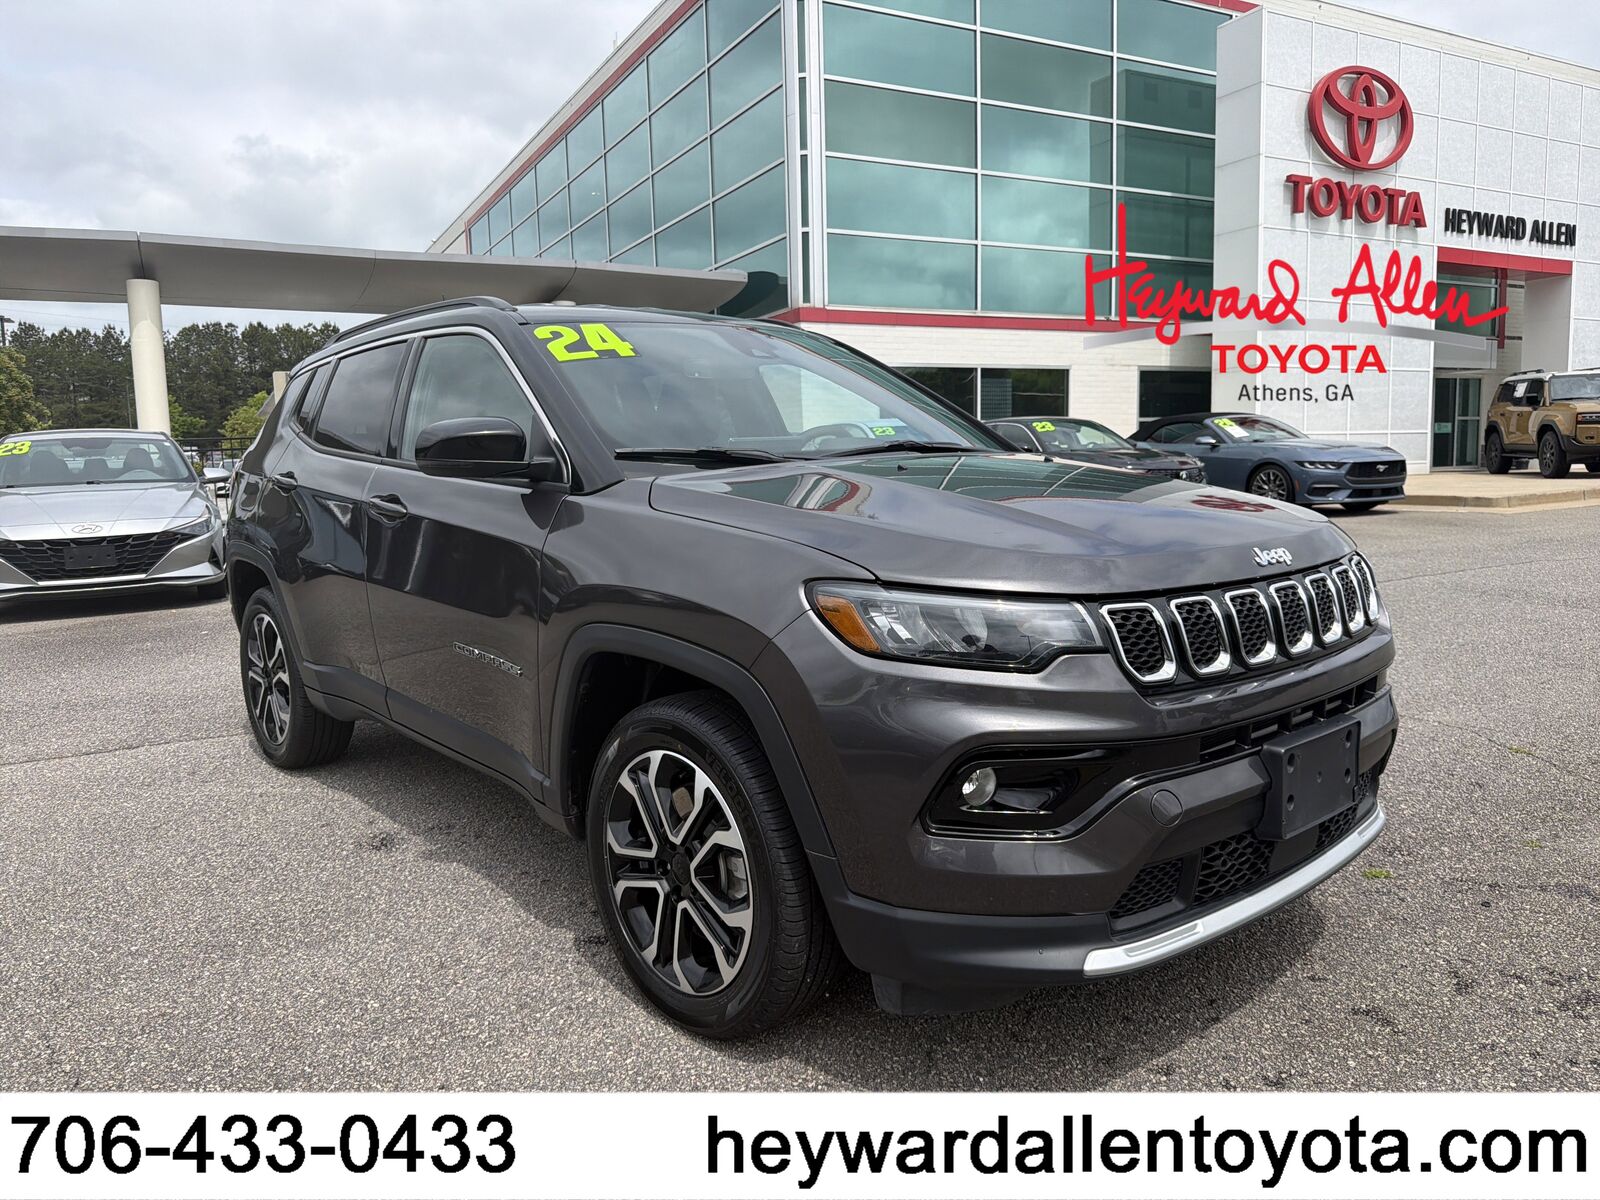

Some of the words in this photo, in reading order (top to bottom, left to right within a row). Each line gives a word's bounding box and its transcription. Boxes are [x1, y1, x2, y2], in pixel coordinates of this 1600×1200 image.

[1286, 174, 1427, 228] TOYOTA
[1444, 207, 1527, 241] HEYWARD
[1529, 220, 1577, 247] ALLEN
[533, 323, 637, 362] 24
[1031, 421, 1056, 432] 23
[0, 441, 32, 457] 23
[1251, 547, 1293, 567] Jeep
[453, 641, 523, 678] COMPASS
